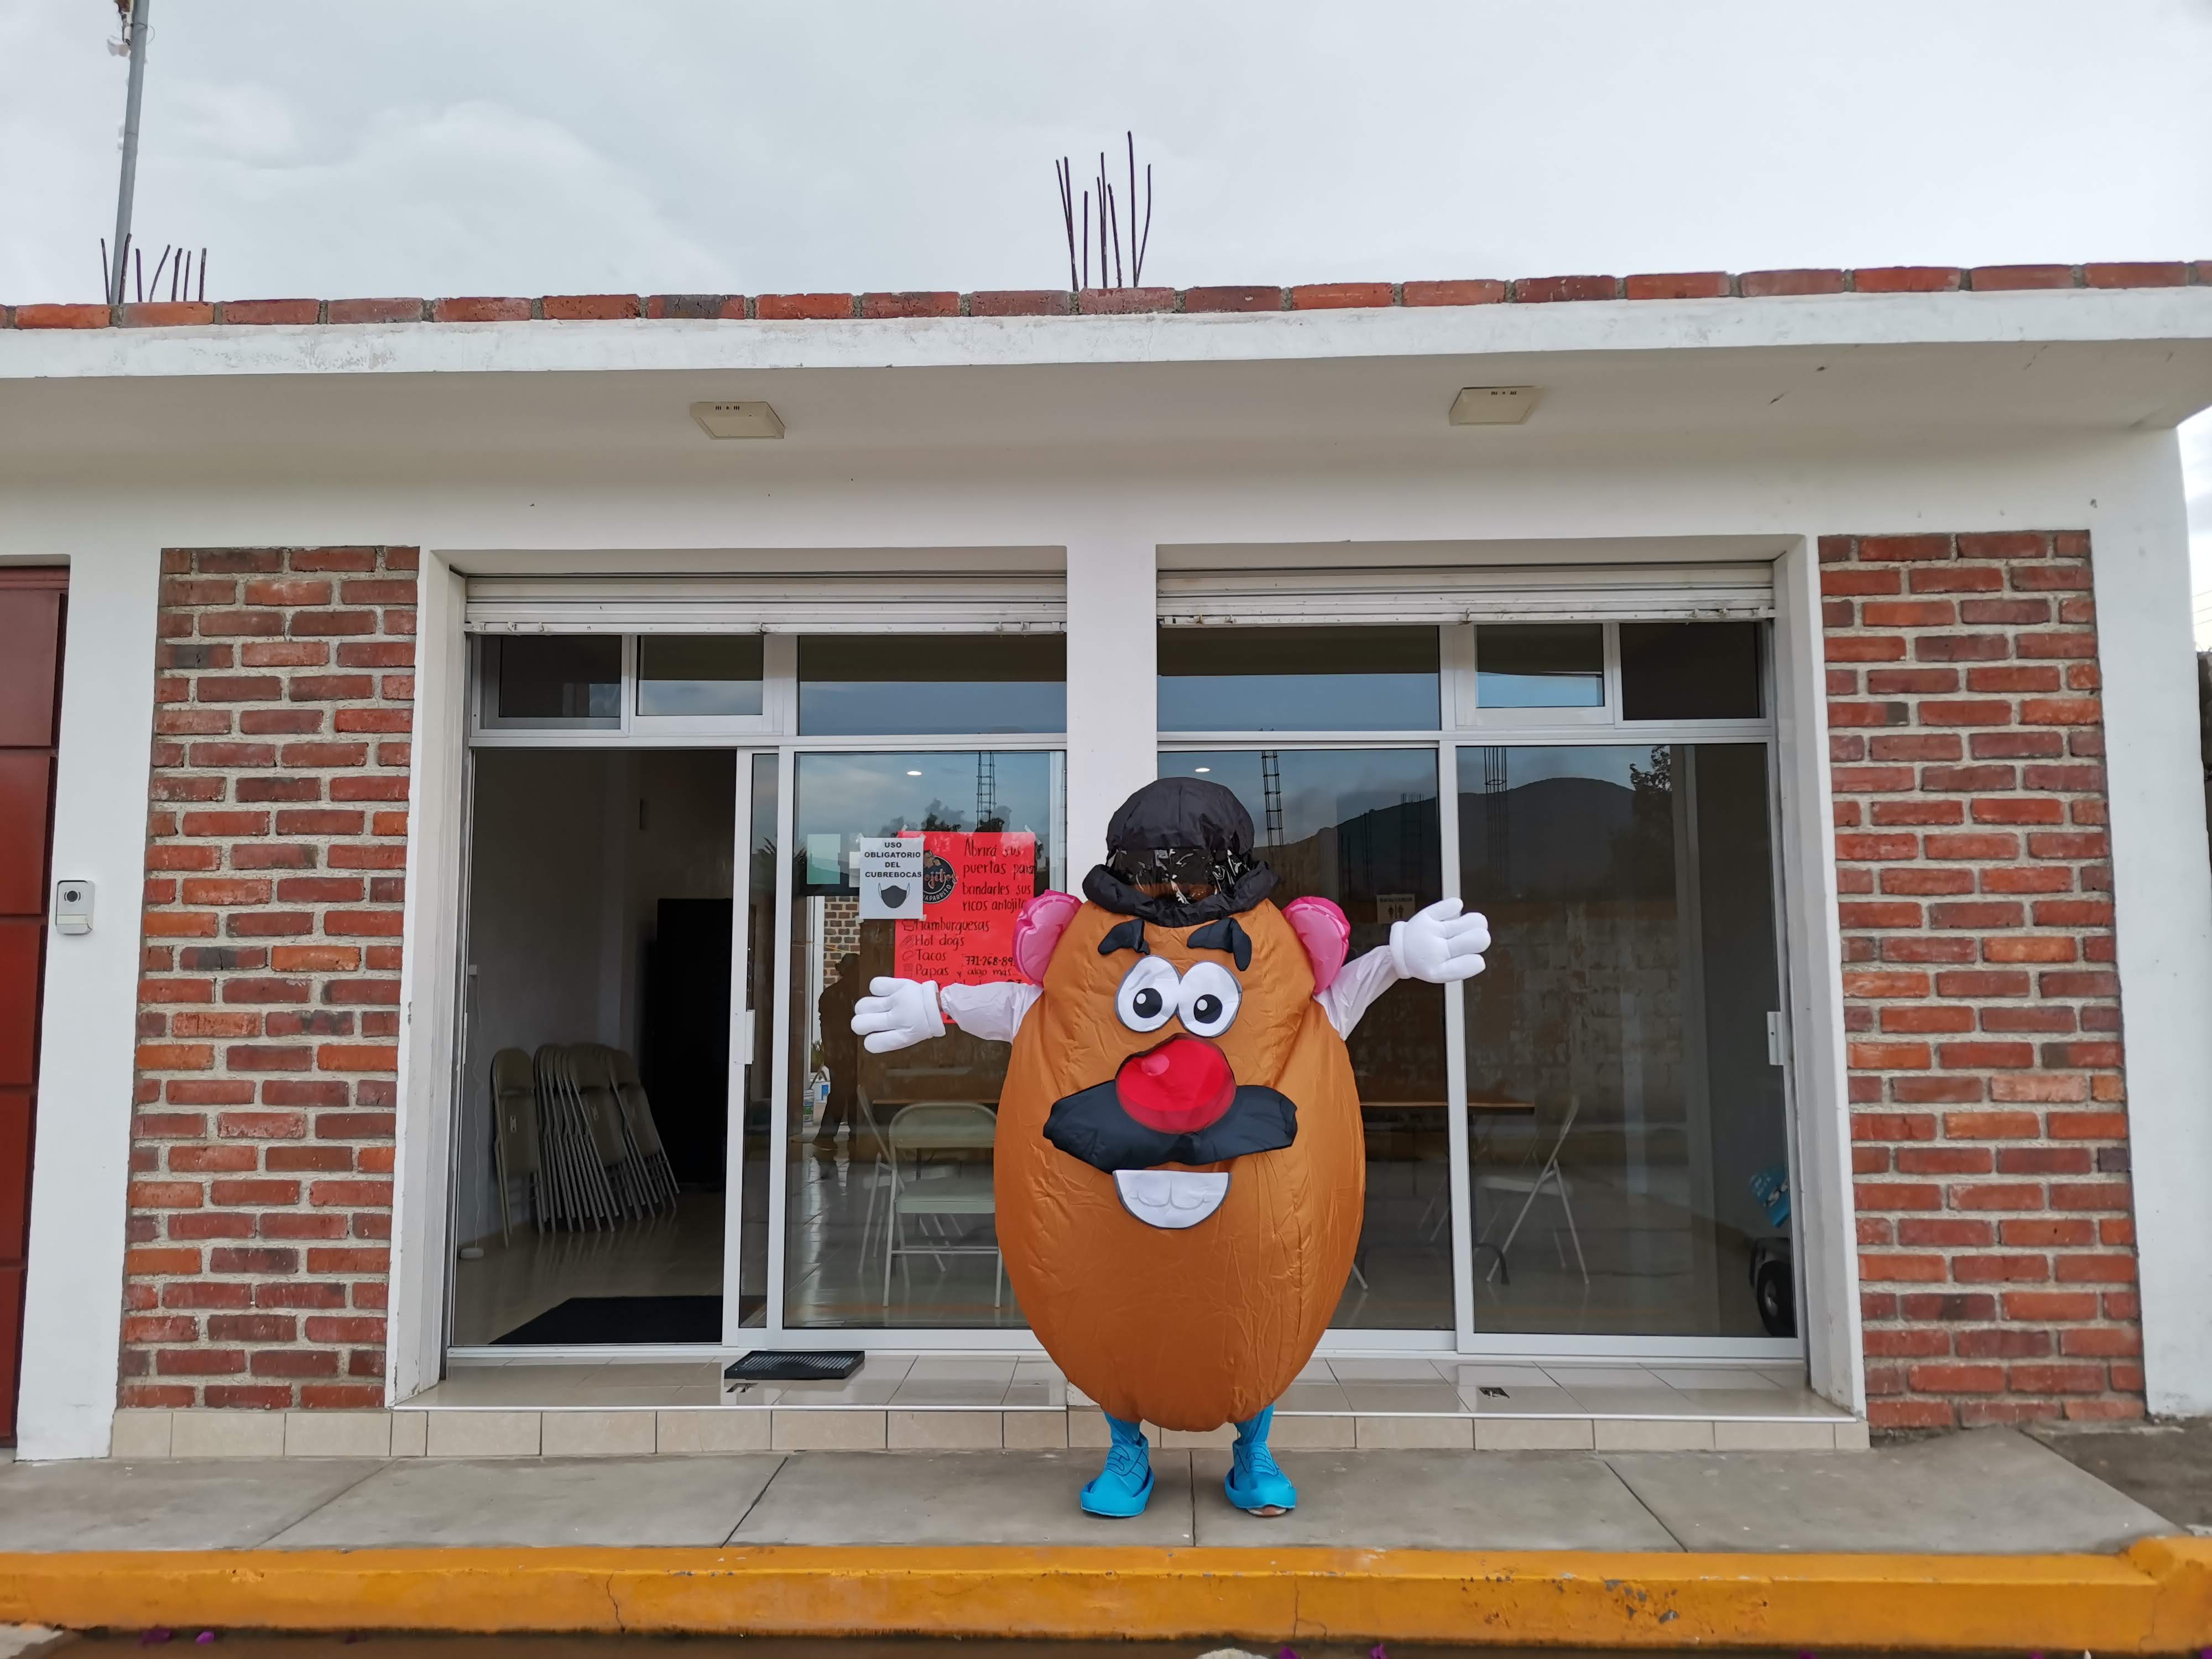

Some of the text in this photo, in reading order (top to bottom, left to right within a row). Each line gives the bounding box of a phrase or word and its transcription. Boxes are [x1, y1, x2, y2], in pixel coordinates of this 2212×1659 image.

[1002, 846, 1021, 857] sus
[963, 860, 1035, 881] puertas para
[923, 884, 952, 902] APARRITO
[962, 881, 1031, 895] brindarles sus
[962, 898, 1026, 914] ricos antojito
[914, 916, 990, 935] Hamburguesas
[915, 933, 965, 951] Hot dogs
[916, 948, 947, 961] Tacos
[916, 963, 950, 978] Papas
[967, 967, 988, 978] algo
